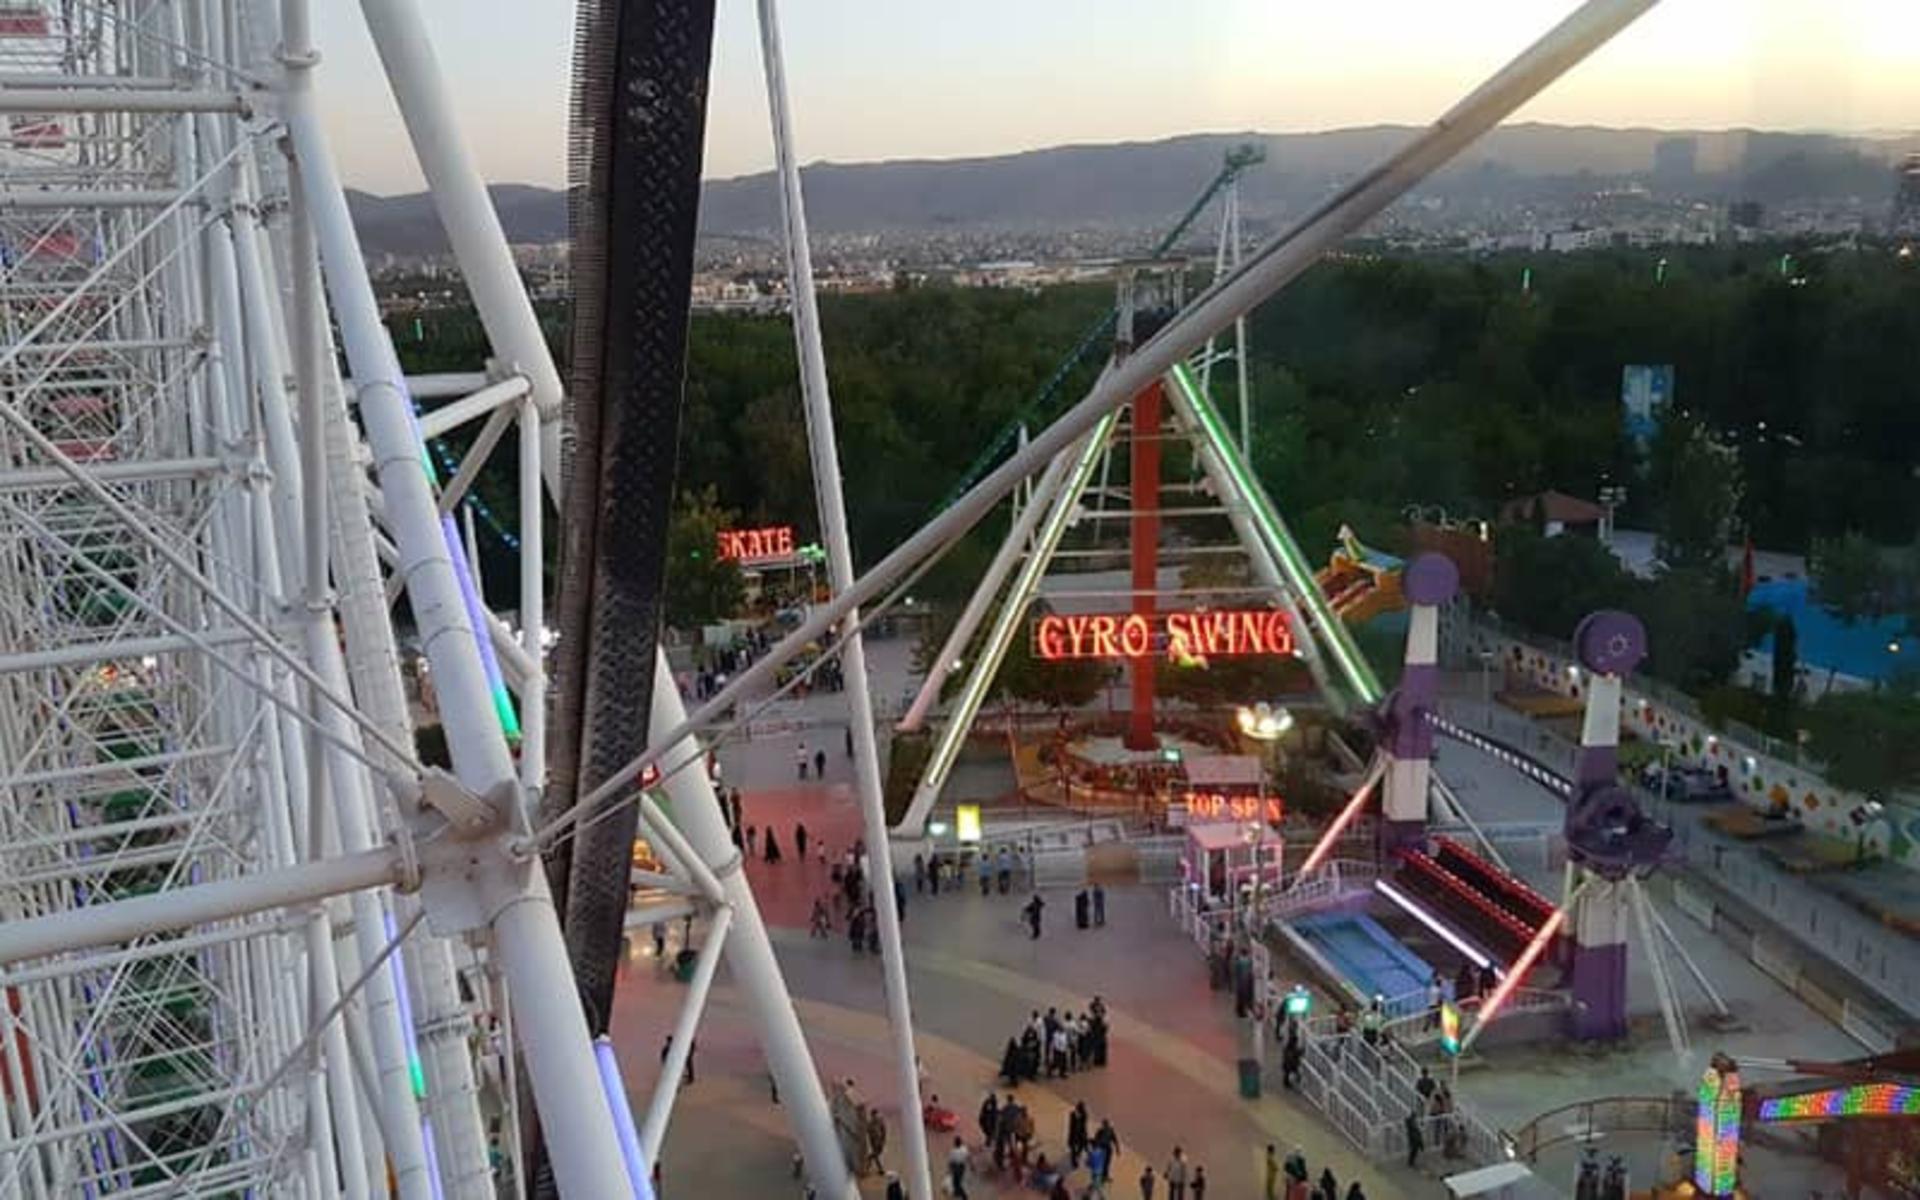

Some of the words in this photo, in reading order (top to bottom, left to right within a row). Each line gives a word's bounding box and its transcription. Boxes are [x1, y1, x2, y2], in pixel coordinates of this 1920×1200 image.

[716, 527, 792, 559] SKATE
[1038, 613, 1149, 658] GYRO
[1167, 610, 1293, 655] SWING
[1184, 793, 1225, 818] TOP
[1230, 795, 1283, 821] SPN
